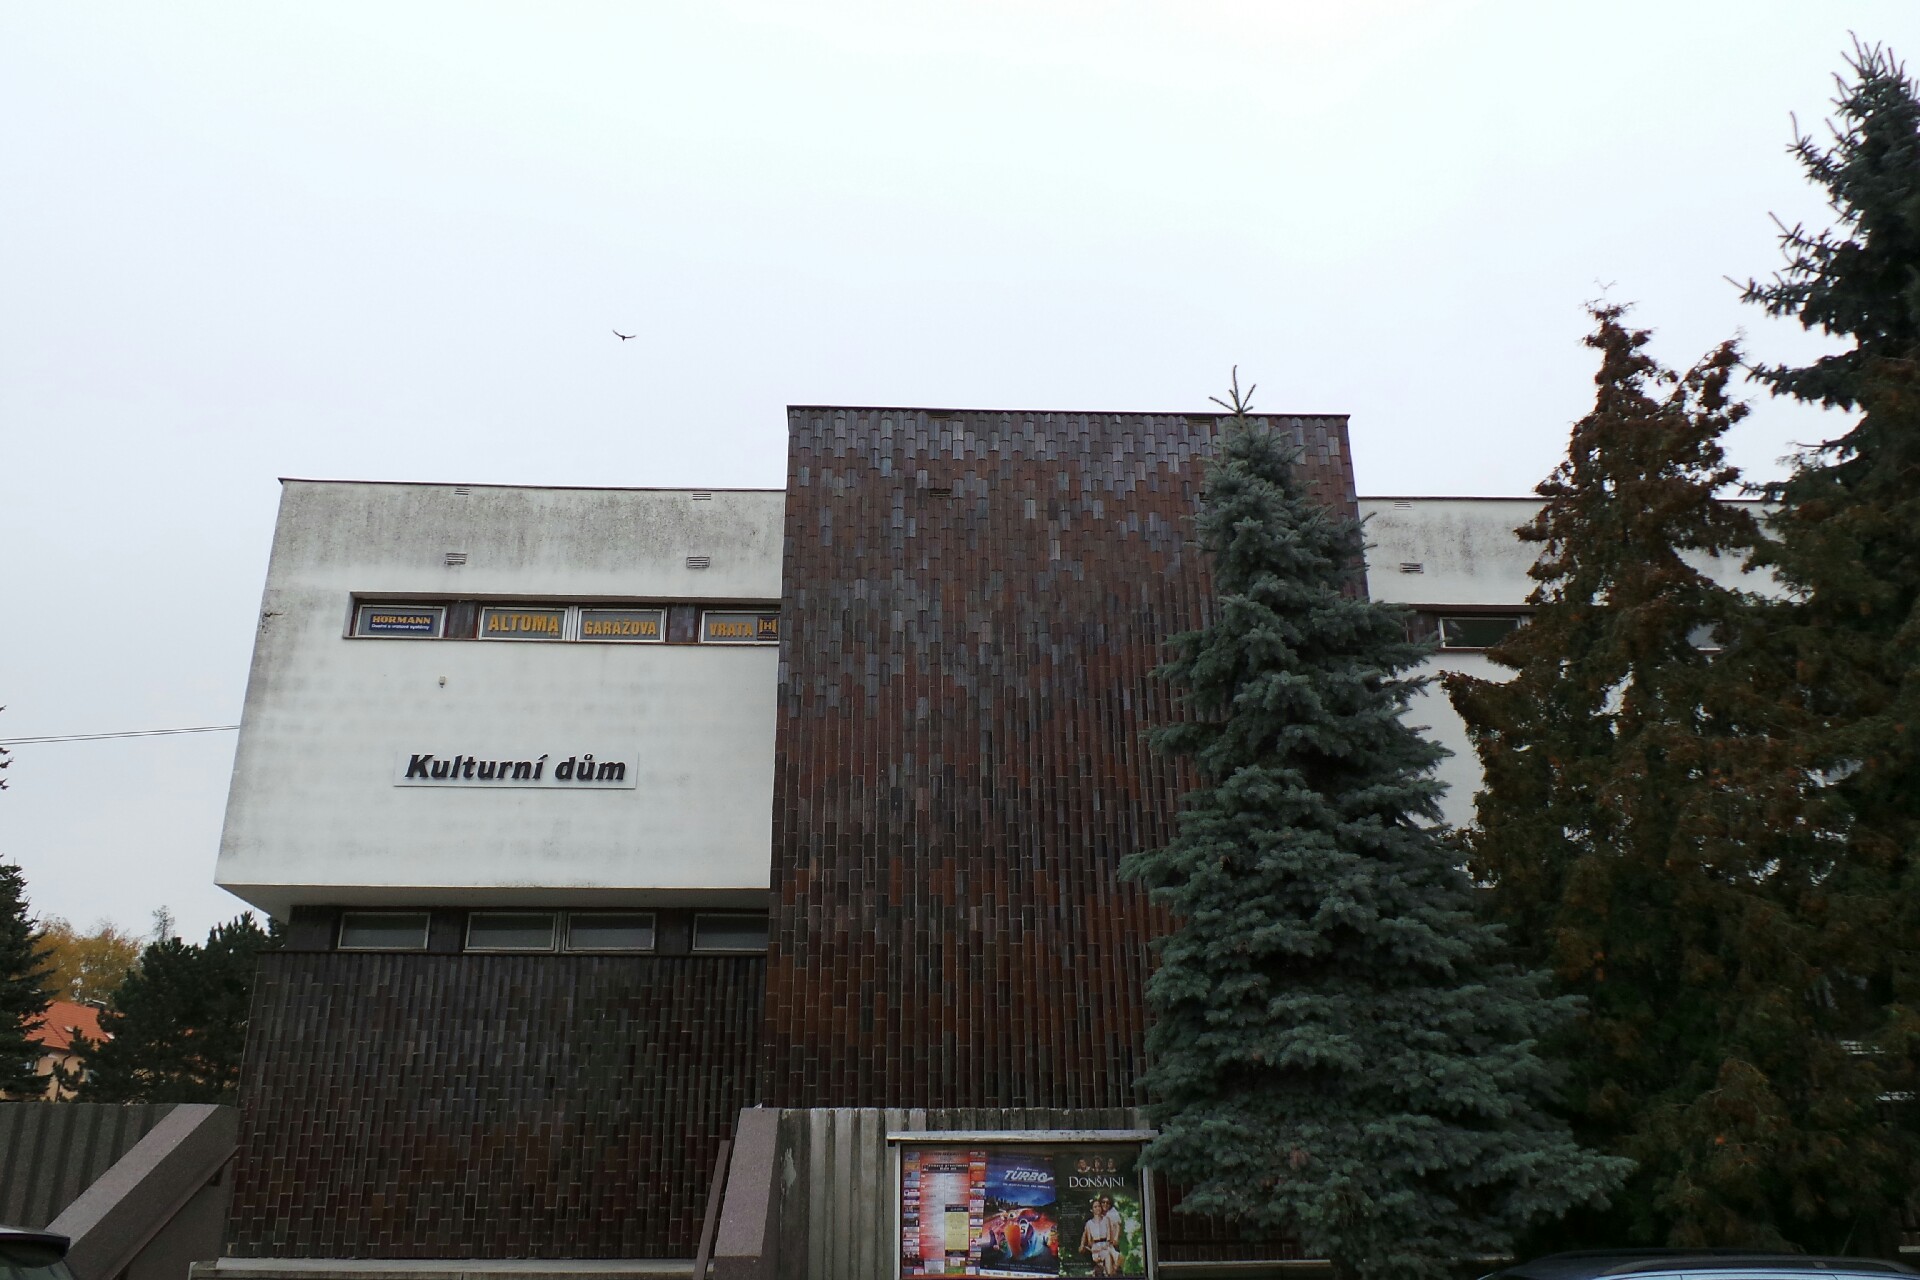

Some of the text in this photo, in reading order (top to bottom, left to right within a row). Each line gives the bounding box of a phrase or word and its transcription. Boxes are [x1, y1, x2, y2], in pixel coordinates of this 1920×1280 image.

[488, 614, 559, 632] ALTOMA
[709, 622, 753, 637] VRATA
[405, 753, 626, 781] Kulturní dům
[1004, 1169, 1054, 1183] TURBO
[1068, 1174, 1125, 1189] DONŠAJNI
